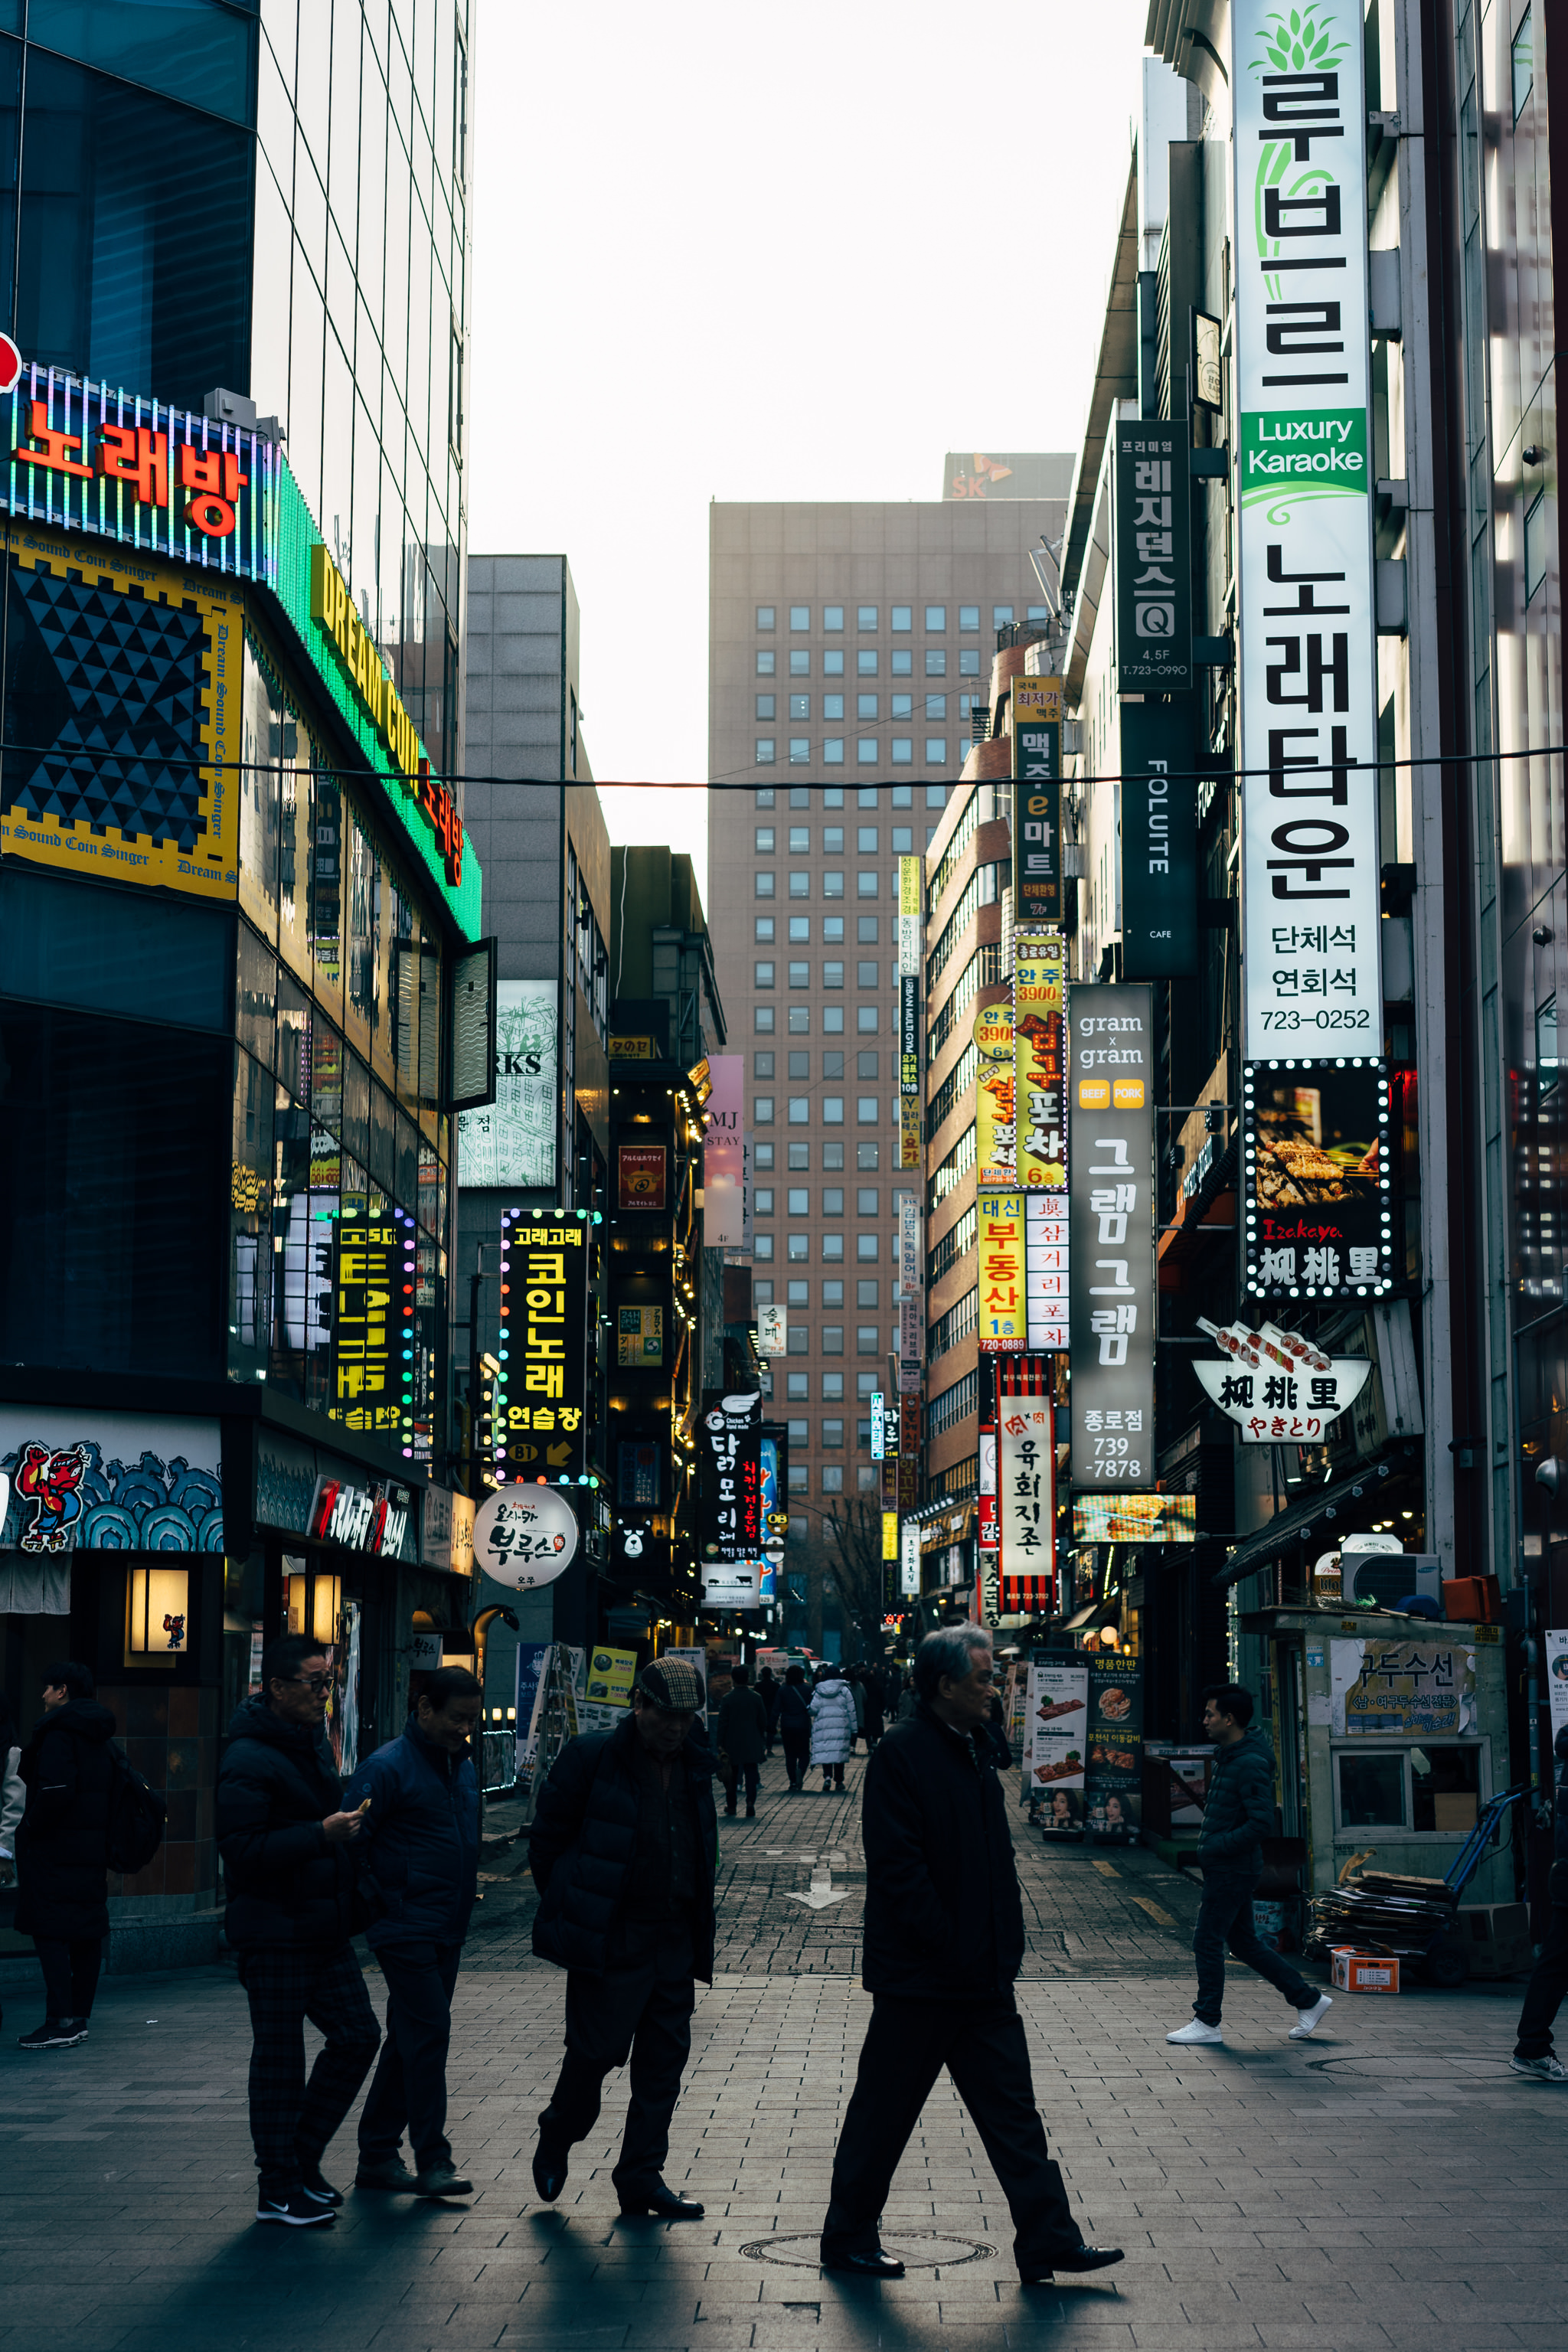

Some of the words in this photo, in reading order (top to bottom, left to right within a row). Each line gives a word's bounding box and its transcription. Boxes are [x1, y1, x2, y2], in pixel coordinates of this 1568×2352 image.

[1259, 72, 1348, 387] 루브르
[1258, 417, 1353, 443] Luxury
[1122, 441, 1172, 452] 프리미엄
[9, 400, 248, 537] 노래방
[1249, 446, 1363, 475] Karaoke
[952, 477, 986, 498] SK
[1133, 461, 1176, 597] 레지던스
[23, 534, 70, 559] Sound
[74, 550, 106, 568] Coin
[109, 559, 158, 582] Singer
[182, 577, 227, 601] Dream
[217, 623, 228, 678] Dream
[1143, 650, 1170, 661] 4.5F
[1122, 665, 1187, 676] T.723-0990
[1018, 682, 1037, 691] 국내
[215, 681, 227, 736] Sound
[1018, 691, 1059, 707] 최저가
[310, 544, 382, 729] DREAM
[381, 678, 419, 800] COIN
[416, 758, 464, 887] 노래방
[1036, 707, 1059, 718] 맥주
[1263, 544, 1357, 900] 노래타운
[213, 781, 224, 839] Singer
[1148, 760, 1169, 874] FOLUITE
[14, 824, 62, 848] Sound
[65, 837, 99, 856] Coin
[100, 842, 150, 867] Singer
[177, 858, 223, 882] Dream
[1023, 884, 1055, 897] 단체환영
[1030, 903, 1047, 915] 7F
[1149, 929, 1171, 939] CAFE
[1271, 924, 1357, 955] 단체석
[1018, 945, 1059, 959] 종로유일
[905, 978, 914, 1006] URBAN
[1272, 968, 1357, 998] 연회석
[905, 1008, 914, 1032] MULTI
[1080, 1017, 1143, 1037] gram
[1260, 1008, 1370, 1032] 723-0252
[905, 1032, 914, 1054] GYM
[1080, 1048, 1144, 1069] gram
[1081, 1088, 1106, 1099] BEEF
[1115, 1087, 1142, 1098] PORK
[710, 1112, 738, 1129] MJ
[707, 1136, 740, 1145] STAY
[1027, 1168, 1054, 1184] 6층
[982, 1199, 1021, 1217] 대신
[514, 1228, 582, 1246] 고래고래
[717, 1233, 730, 1243] 4F
[1263, 1219, 1343, 1243] Izakaya
[1089, 1138, 1138, 1367] 그램그램
[984, 1223, 1019, 1313] 부동산
[524, 1253, 567, 1398] 코인노래
[989, 1318, 1015, 1334] 1층
[982, 1339, 1024, 1351] 720-0889
[508, 1406, 583, 1432] 연습장
[884, 1409, 900, 1442] 타로
[1084, 1410, 1144, 1433] 종로점
[1247, 1416, 1321, 1439] やきとり
[514, 1446, 531, 1461] B1
[1093, 1436, 1129, 1457] 739
[743, 1461, 756, 1491] 치킨
[1086, 1459, 1142, 1479] -7878
[1014, 1440, 1041, 1555] 육회지존
[743, 1495, 757, 1539] 전문점
[767, 1514, 788, 1524] OB
[487, 1525, 558, 1566] 부루스
[1095, 1658, 1136, 1671] 명품한판
[1359, 1651, 1454, 1687] 구두수선
